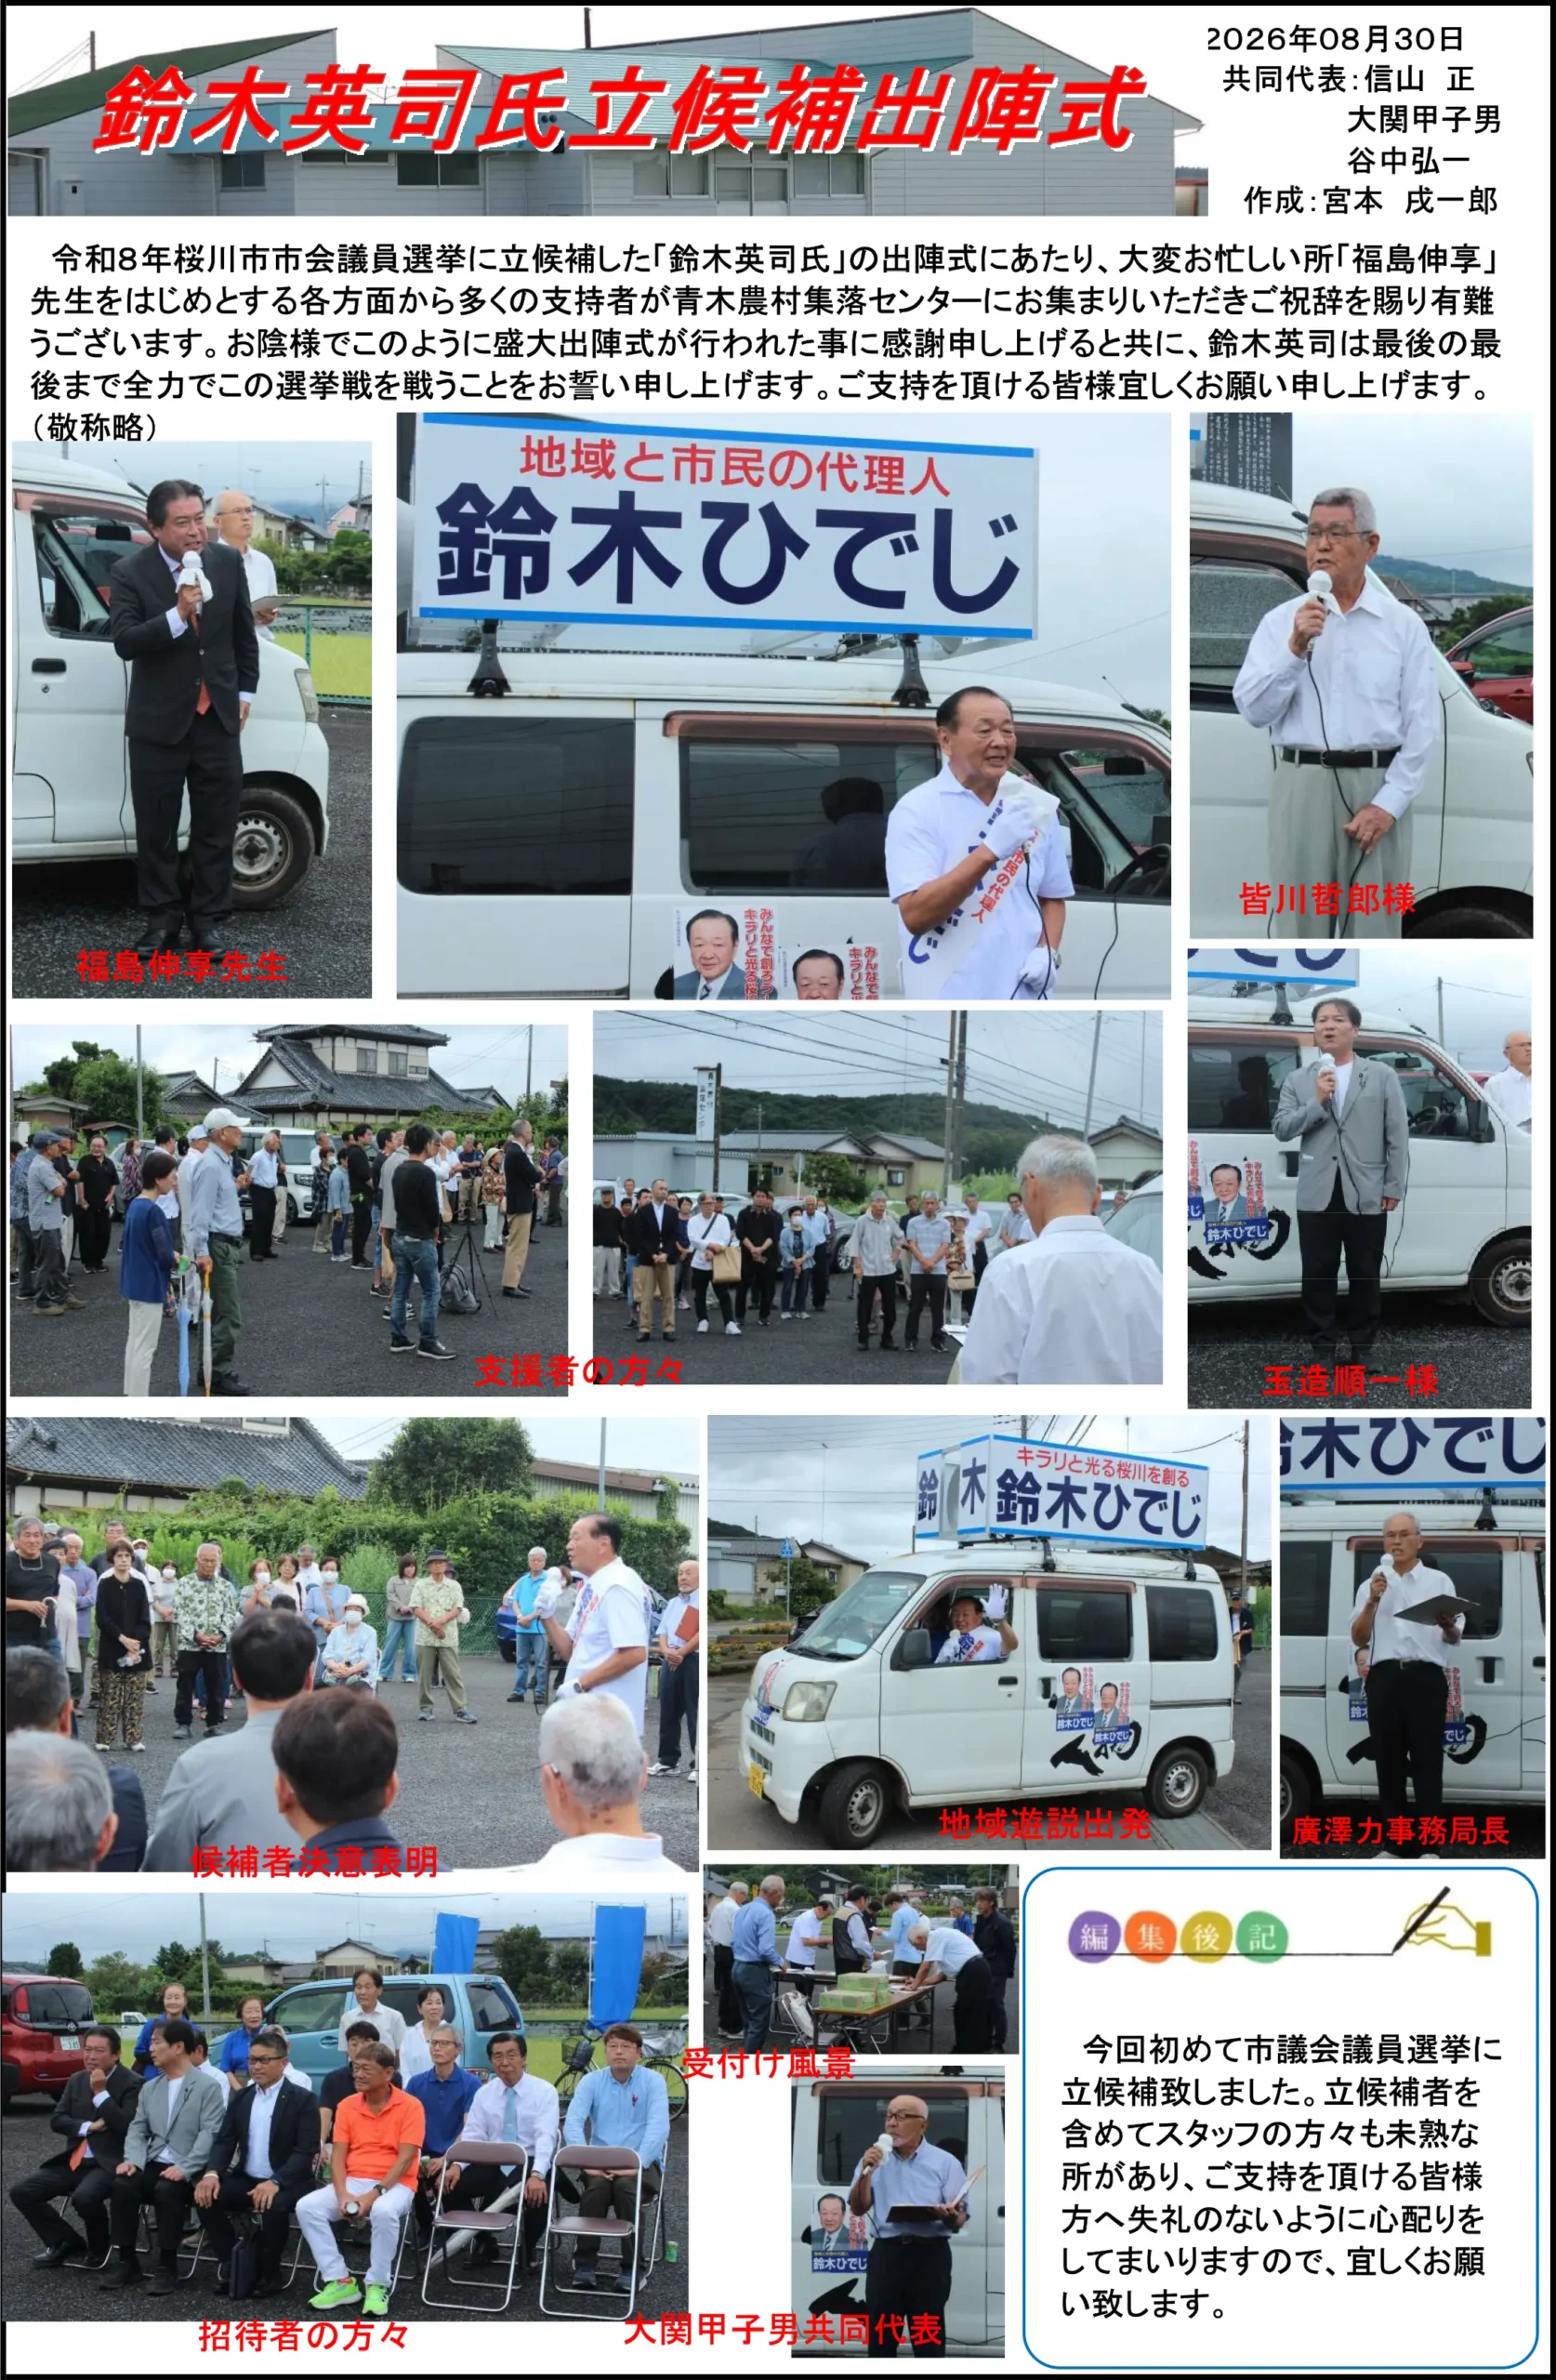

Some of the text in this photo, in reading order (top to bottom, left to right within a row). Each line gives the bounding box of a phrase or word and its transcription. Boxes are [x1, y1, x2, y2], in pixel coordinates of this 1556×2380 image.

[1208, 25, 1462, 53] 2026年08月30日
[1222, 63, 1475, 93] 共同代表：信山 正
[1347, 104, 1501, 134] 大関甲子男
[1347, 146, 1470, 175] 谷中弘一
[1244, 185, 1497, 215] 作成：宮本 戌一郎
[30, 284, 1495, 316] 先生をはじめとする各方面から多くの支持者が青木農村集落センターにお集まりいただきご祝辞を賜り有難
[30, 327, 1501, 358] うございます。お陰様でこのように盛大出陣式が行われた事に感謝申し上げると共に、鈴木英司は最後の最
[30, 369, 1485, 401] 後まで全力でこの選挙戦を戦うことをお誓い申し上げます。ご支持を頂ける皆様宜しくお願い申し上げます。
[34, 412, 156, 442] （敬称略）
[520, 435, 951, 498] 地域と市民の代理人
[436, 483, 1021, 615] 鈴木ひでじ
[1207, 1226, 1267, 1242] 鈴木ひでじ
[1017, 1446, 1189, 1488] キラリと光る桜川を創る
[917, 1456, 987, 1522] 鈴 木
[996, 1468, 1202, 1539] 鈴木ひでじ
[1080, 1923, 1276, 1951] 編集後記
[1083, 2033, 1502, 2065] 今回初めて市議会議員選挙に
[1062, 2076, 1481, 2108] 立候補致しました。立候補者を
[1062, 2118, 1479, 2149] 含めてスタッフの方々も未熟な
[1062, 2161, 1483, 2192] 所があり、ご支持を頂ける皆様
[1062, 2203, 1484, 2235] 方へ失礼のないように心配りを
[813, 2257, 866, 2270] 鈴木ひでじ
[1062, 2245, 1485, 2277] してまいりますので、宜しくお願
[1062, 2288, 1223, 2319] い致します。
